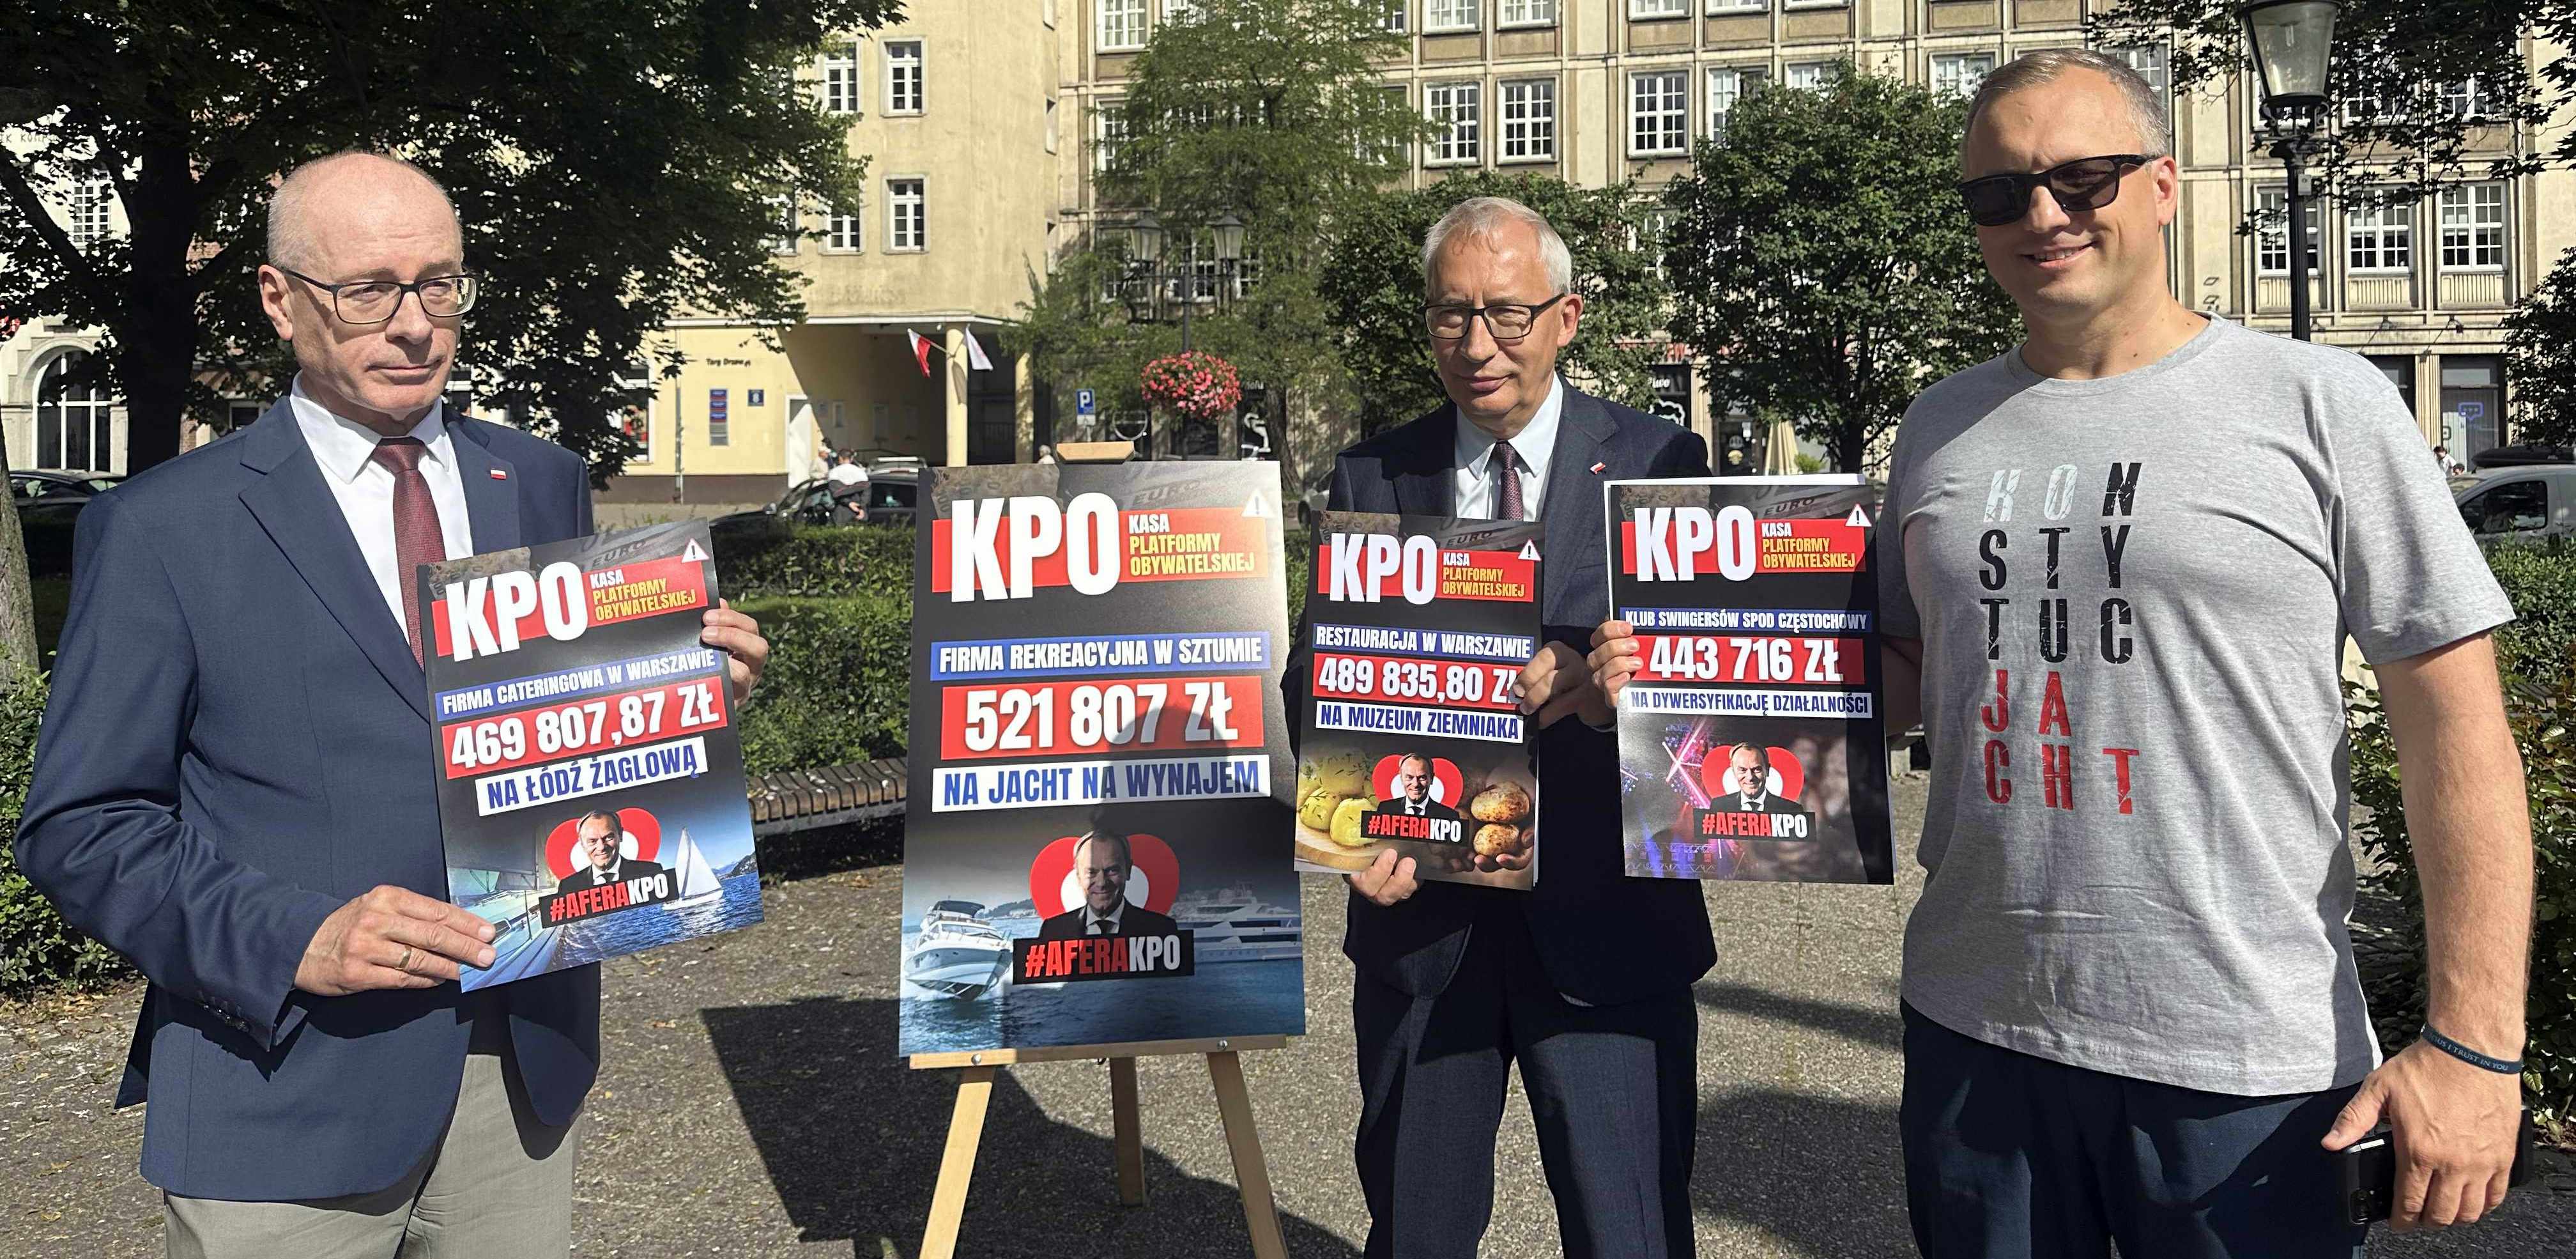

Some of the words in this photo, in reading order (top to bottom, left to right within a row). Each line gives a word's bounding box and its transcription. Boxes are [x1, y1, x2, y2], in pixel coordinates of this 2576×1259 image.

[1079, 391, 1091, 408] P
[1128, 513, 1169, 534] KASA
[1761, 522, 1791, 537] KASA
[951, 492, 1120, 602] KPO
[1130, 534, 1221, 555] PLATFORMY
[1634, 505, 1756, 582] KPO
[1763, 538, 1830, 553] PLATFORMY
[1130, 553, 1255, 576] OBYWATELSKIEJ
[1330, 532, 1437, 605] KPO
[1443, 552, 1470, 566] KASA
[1763, 553, 1855, 568] OBYWATELSKIEJ
[590, 569, 624, 588] KASA
[1443, 567, 1503, 582] PLATFORMY
[592, 578, 667, 605] PLATFORMY
[1442, 581, 1525, 598] OBYWATELSKIEJ
[444, 562, 588, 662] KPO
[595, 590, 696, 621] OBYWATELSKIEJ
[1625, 611, 1655, 627] KLUB
[1659, 610, 1738, 628] SWINGERSÓW
[1742, 613, 1774, 628] SPOD
[1778, 613, 1866, 633] CZĘSTOCHOWY
[940, 645, 1004, 673] FIRMA
[1010, 640, 1147, 670] REKREACYJNA
[1154, 639, 1173, 665] W
[1179, 637, 1262, 664] SZTUMIE
[1316, 626, 1417, 651] RESTAURACJA
[1422, 633, 1436, 652] W
[1441, 634, 1531, 658] WARSZAWIE
[1650, 637, 1719, 679] 443
[1729, 638, 1793, 680] 716
[1803, 639, 1844, 682] ZŁ
[442, 688, 493, 715] FIRMA
[496, 669, 604, 704] CATERINGOWA
[606, 665, 622, 685] W
[627, 649, 716, 681] WARSZAWIE
[1319, 658, 1374, 694] 489
[1383, 661, 1482, 703] 835,80
[965, 688, 1054, 752] 521
[1069, 683, 1168, 748] 807
[1184, 682, 1238, 742] ZŁ
[1631, 692, 1648, 707] NA
[1653, 692, 1768, 716] DYWERSYFIKACJĘ
[1774, 692, 1868, 713] DZIAŁALNOŚCI
[451, 719, 526, 769] 469
[536, 692, 666, 755] 807,87
[677, 683, 719, 727] ZŁ
[1321, 705, 1342, 725] NA
[1348, 707, 1422, 731] MUZEUM
[1427, 712, 1519, 739] ZIEMNIAKA
[487, 778, 519, 809] NA
[526, 761, 583, 801] ŁÓDŹ
[592, 744, 699, 789] ŻAGLOWĄ
[944, 773, 977, 806] NA
[989, 769, 1073, 803] JACHT
[1082, 765, 1123, 799] NA
[1126, 761, 1259, 796] WYNAJEM
[1368, 814, 1461, 842] #AFERAKPO
[1703, 812, 1807, 838] #AFERAKPO
[551, 873, 668, 922] #AFERAKPO
[1025, 935, 1181, 977] #AFERAKPO
[2453, 1046, 2480, 1062] TRUST
